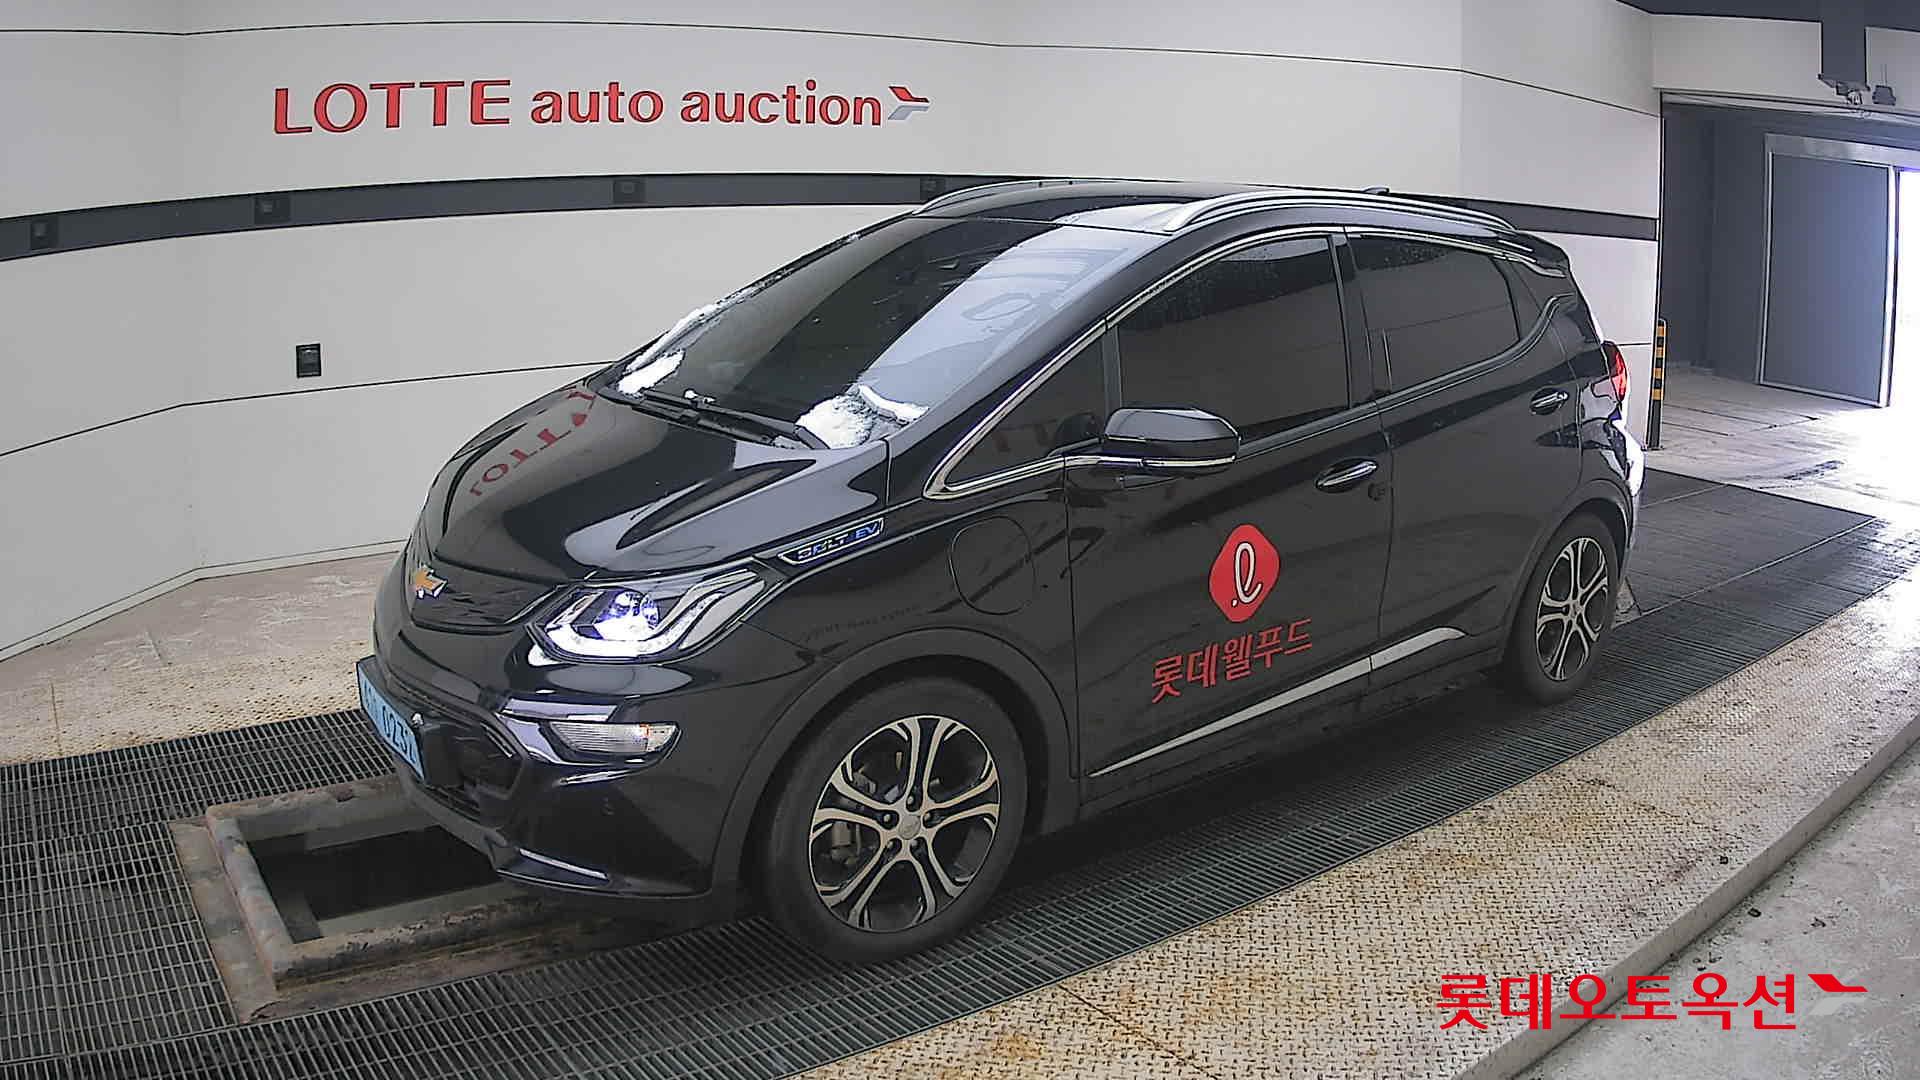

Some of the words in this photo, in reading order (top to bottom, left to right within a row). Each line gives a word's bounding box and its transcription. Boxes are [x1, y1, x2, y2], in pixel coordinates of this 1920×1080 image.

[273, 80, 511, 134] LOTTE
[530, 81, 663, 125] auto
[680, 80, 883, 126] auction
[855, 522, 879, 539] EV
[1151, 617, 1313, 705] 롯데웰푸드
